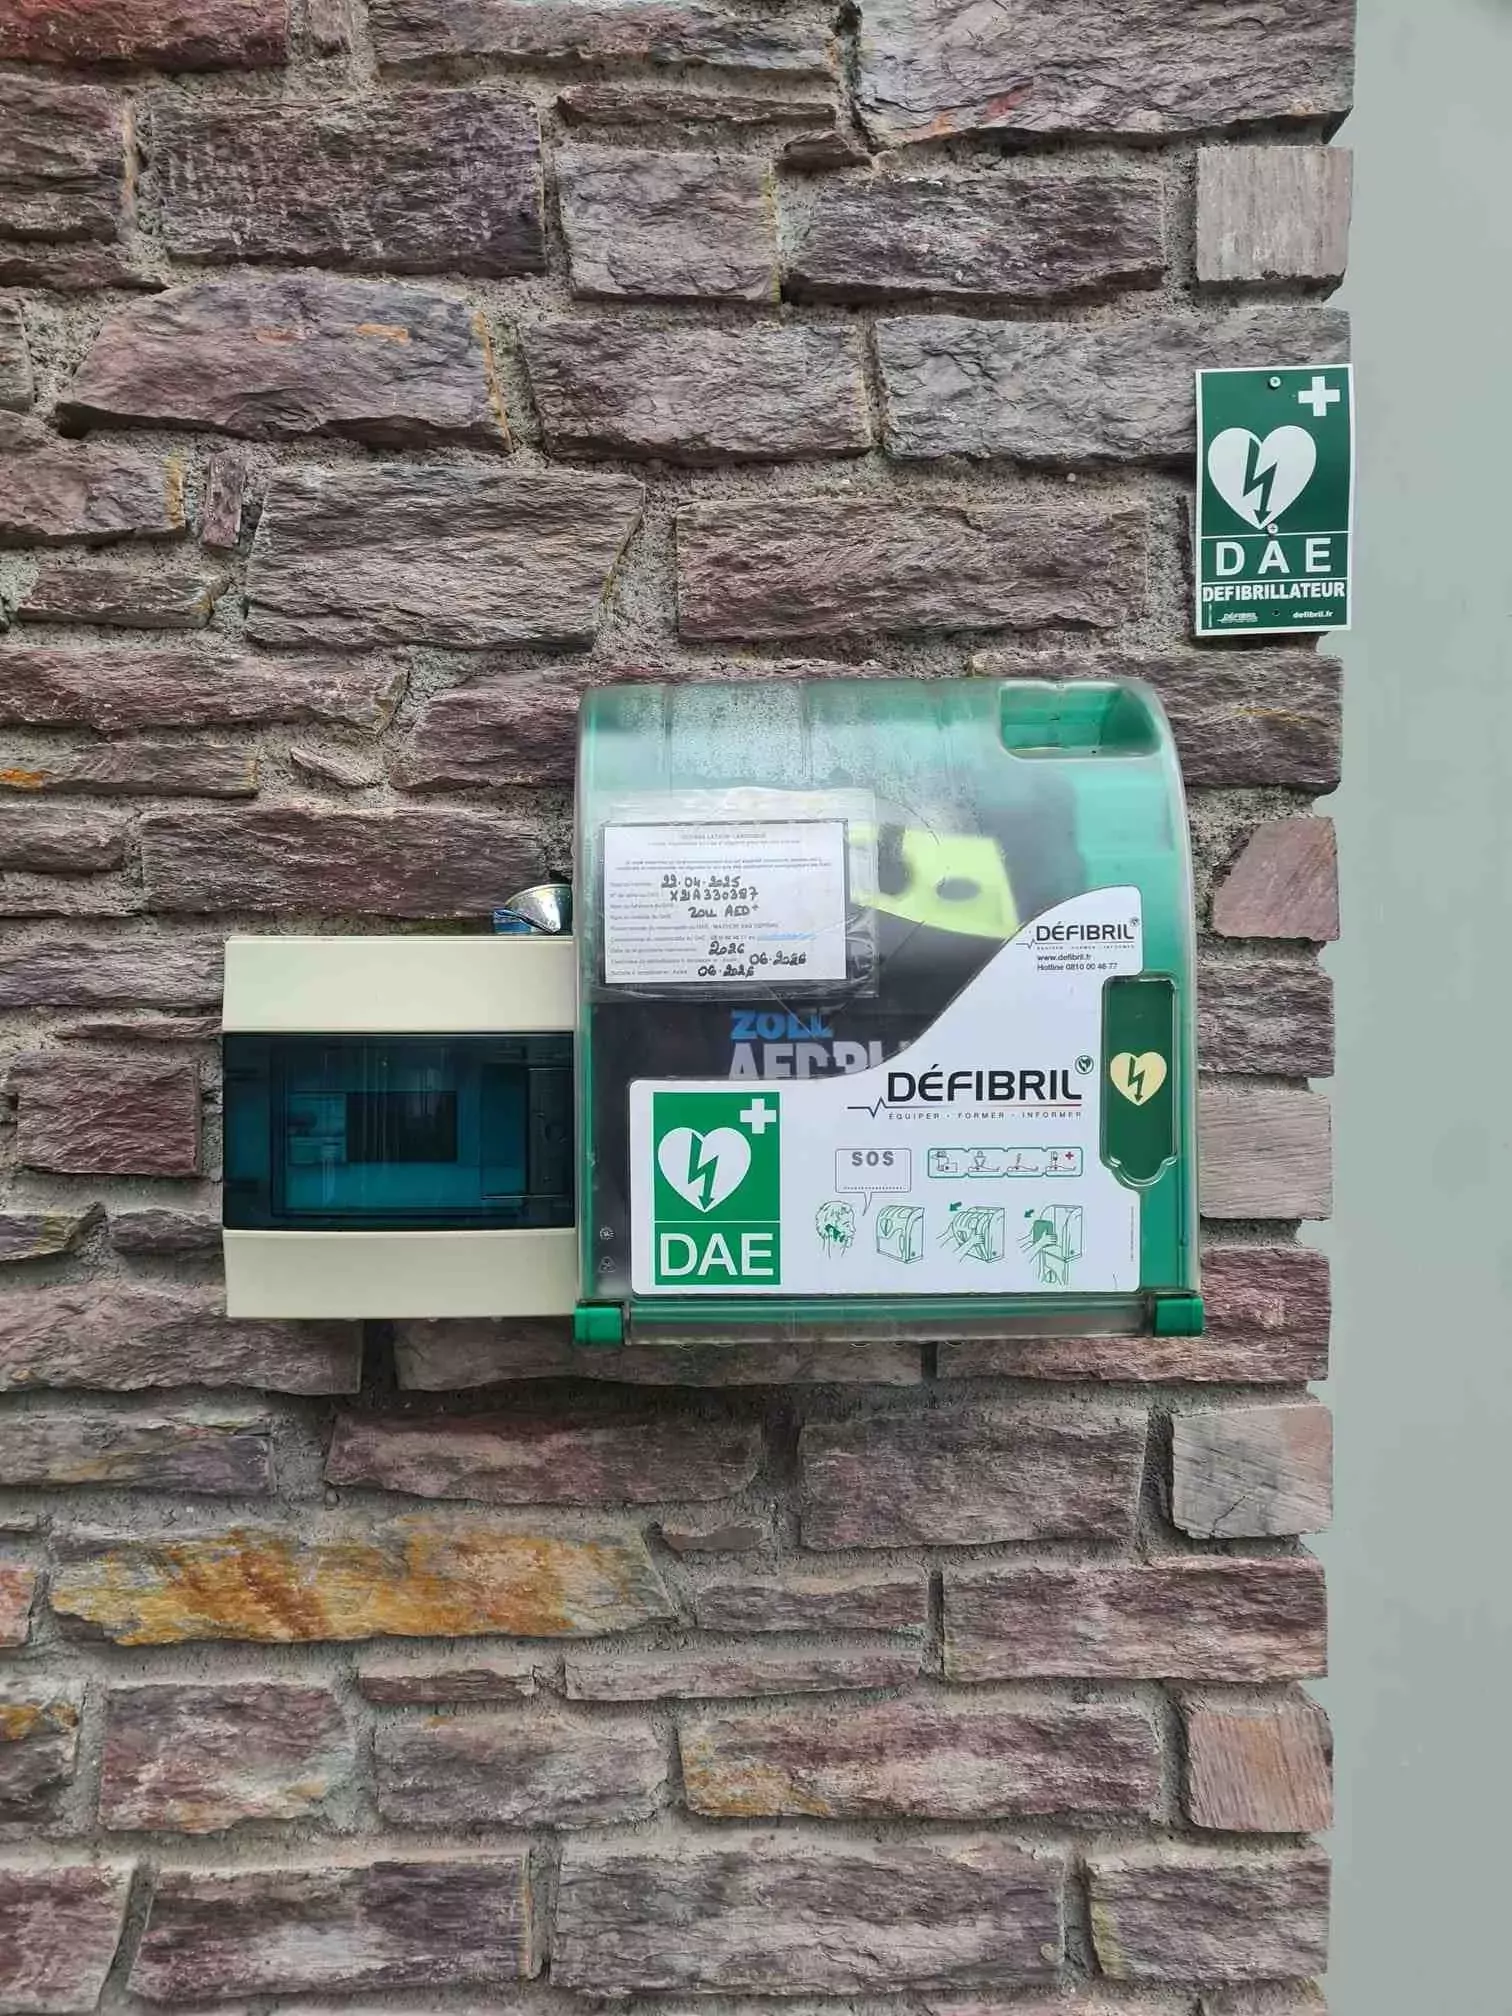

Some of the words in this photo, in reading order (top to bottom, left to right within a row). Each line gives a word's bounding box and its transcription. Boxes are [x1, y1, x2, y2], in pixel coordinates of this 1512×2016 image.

[1202, 581, 1346, 602] DEFIBRILLATEUR
[1292, 609, 1334, 619] defibril.fr
[1036, 921, 1135, 941] DÉFIBRIL
[708, 941, 745, 956] 2026
[730, 1009, 834, 1040] ZOLL
[887, 1063, 1082, 1102] DÉFIBRIL
[958, 1111, 1005, 1119] FORMER
[1021, 1110, 1082, 1119] INFORMER
[851, 1150, 895, 1167] SOS
[659, 1232, 774, 1276] DAE
